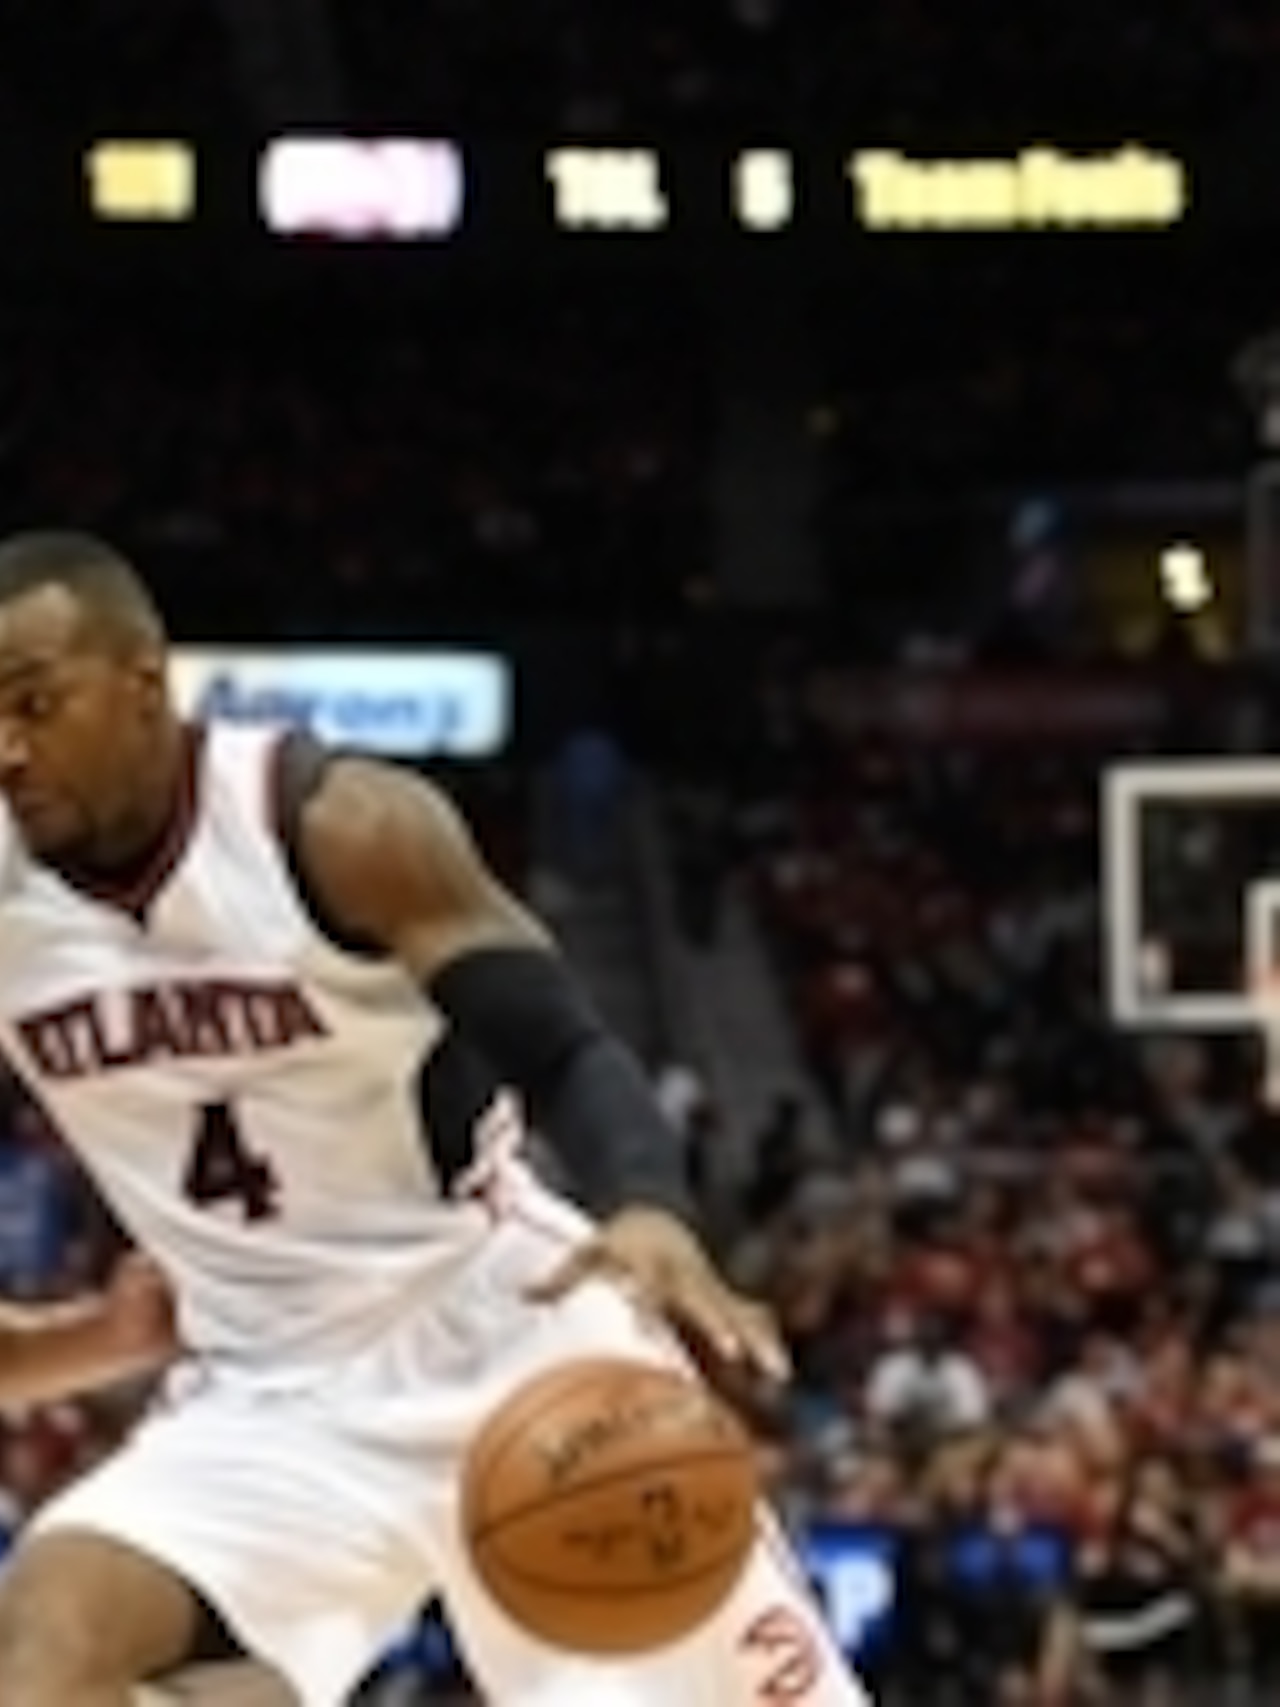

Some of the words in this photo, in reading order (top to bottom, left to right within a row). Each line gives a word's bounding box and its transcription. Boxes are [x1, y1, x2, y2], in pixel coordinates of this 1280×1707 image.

[852, 149, 1015, 228] Team
[16, 976, 334, 1080] ATLANTA
[184, 1099, 282, 1223] 4
